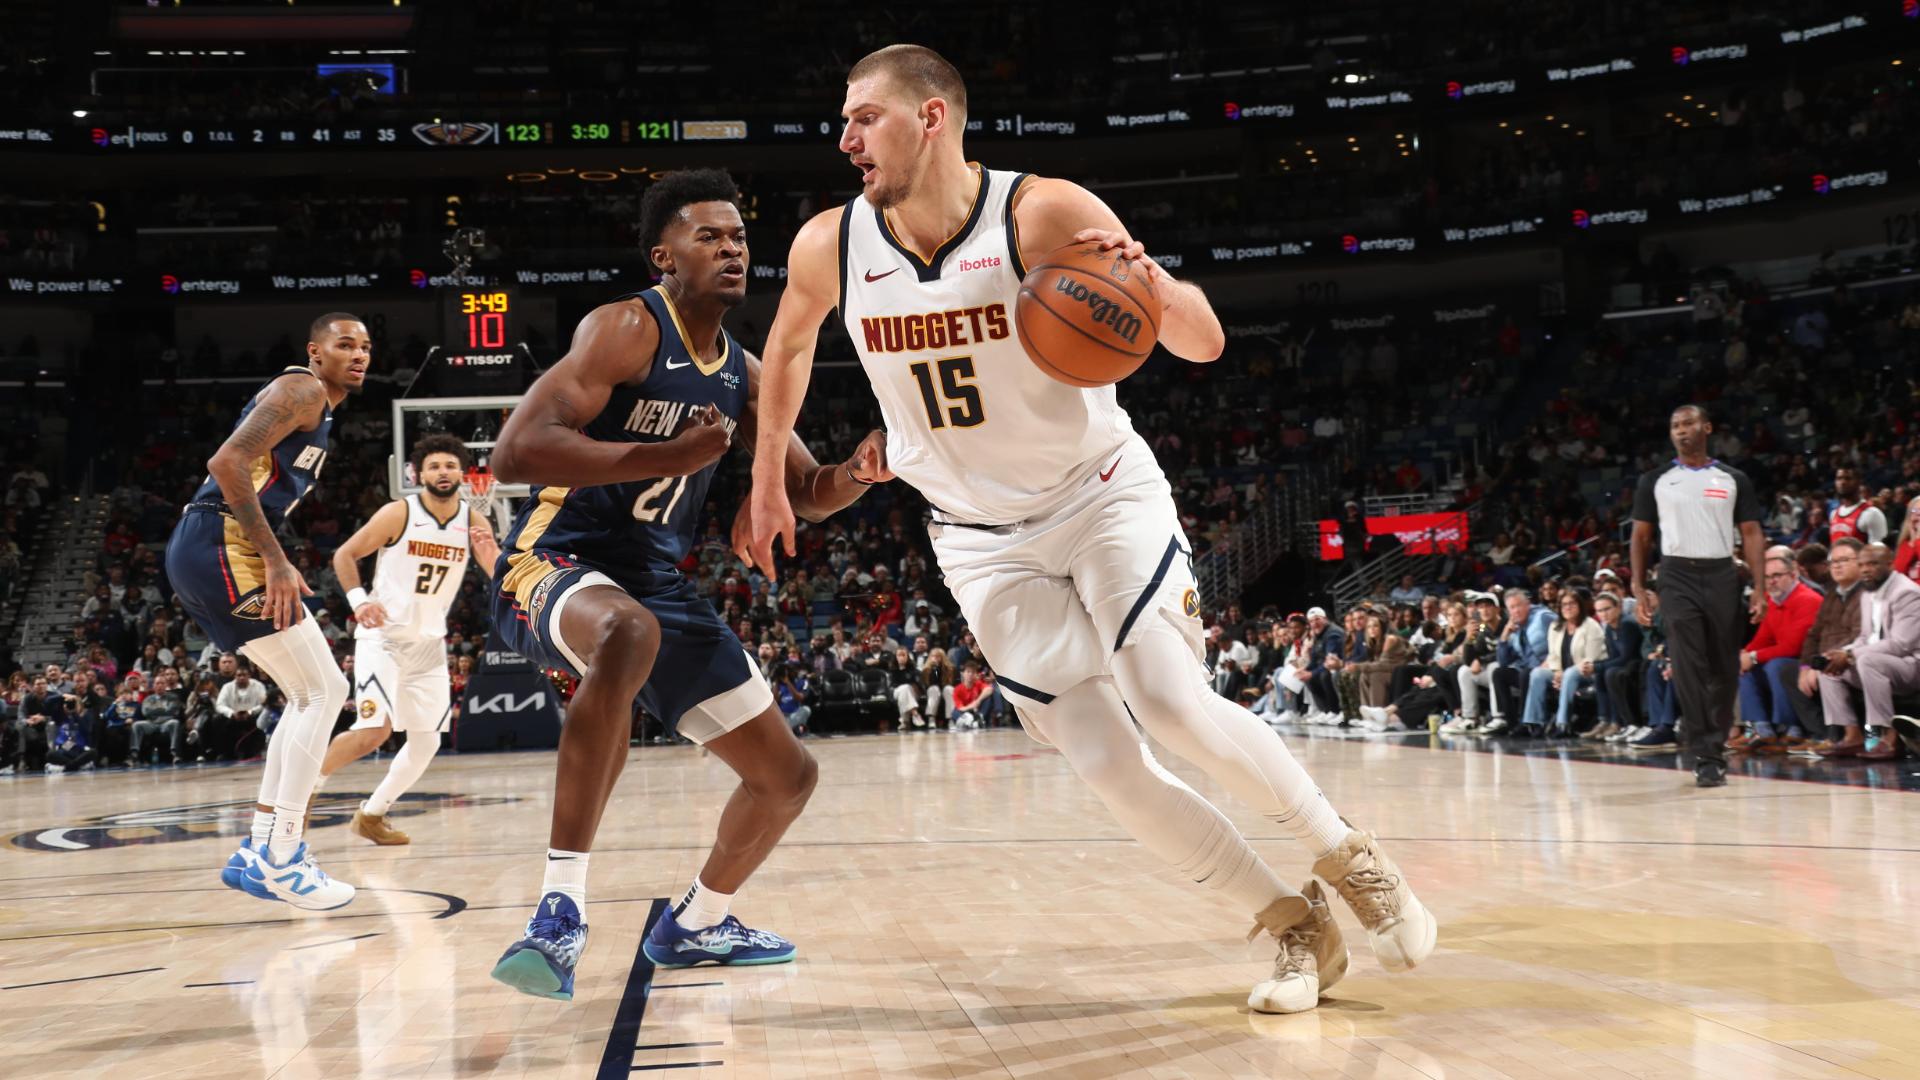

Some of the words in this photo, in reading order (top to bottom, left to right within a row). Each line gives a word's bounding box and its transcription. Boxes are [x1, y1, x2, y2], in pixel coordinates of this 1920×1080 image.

[1690, 45, 1747, 62] entergy
[1547, 69, 1569, 80] We
[1569, 64, 1609, 79] power
[1463, 80, 1515, 96] entergy
[1327, 97, 1347, 108] We
[1349, 95, 1388, 108] power
[1241, 105, 1294, 117] entergy
[774, 124, 804, 133] FOULS
[820, 122, 830, 134] 0
[996, 119, 1011, 131] 31
[1024, 121, 1075, 134] entergy
[1107, 115, 1127, 126] We
[1129, 114, 1166, 126] power
[135, 132, 168, 141] FOULS
[183, 131, 193, 143] 0
[253, 130, 263, 142] 2
[313, 129, 329, 141] 41
[344, 130, 361, 139] AST
[378, 129, 396, 141] 35
[506, 125, 540, 141] 123
[572, 124, 609, 139] 3:50
[638, 123, 669, 139] 121
[1831, 171, 1887, 189] entergy
[1679, 200, 1703, 212] We
[1706, 194, 1749, 211] power
[1590, 210, 1647, 227] entergy
[1444, 229, 1465, 241] We
[1468, 224, 1509, 240] power
[1360, 238, 1415, 251] entergy
[1212, 248, 1234, 259] We
[1236, 246, 1277, 260] power
[754, 266, 775, 277] We
[959, 257, 1001, 272] ibotta
[9, 279, 33, 291] We
[38, 282, 84, 293] power
[272, 276, 295, 288] We
[299, 277, 343, 290] power
[517, 272, 539, 282] We
[542, 272, 584, 284] power
[181, 280, 240, 293] entergy
[462, 293, 508, 313] 3:49
[1056, 275, 1143, 344] Wilson
[469, 313, 504, 349] 10
[861, 303, 1010, 354] NUGGETS
[464, 354, 515, 366] TISSOT
[909, 355, 985, 429] 15
[624, 398, 686, 438] NEW
[632, 474, 688, 525] 21
[407, 540, 465, 563] NUGGETS
[414, 563, 449, 595] 27
